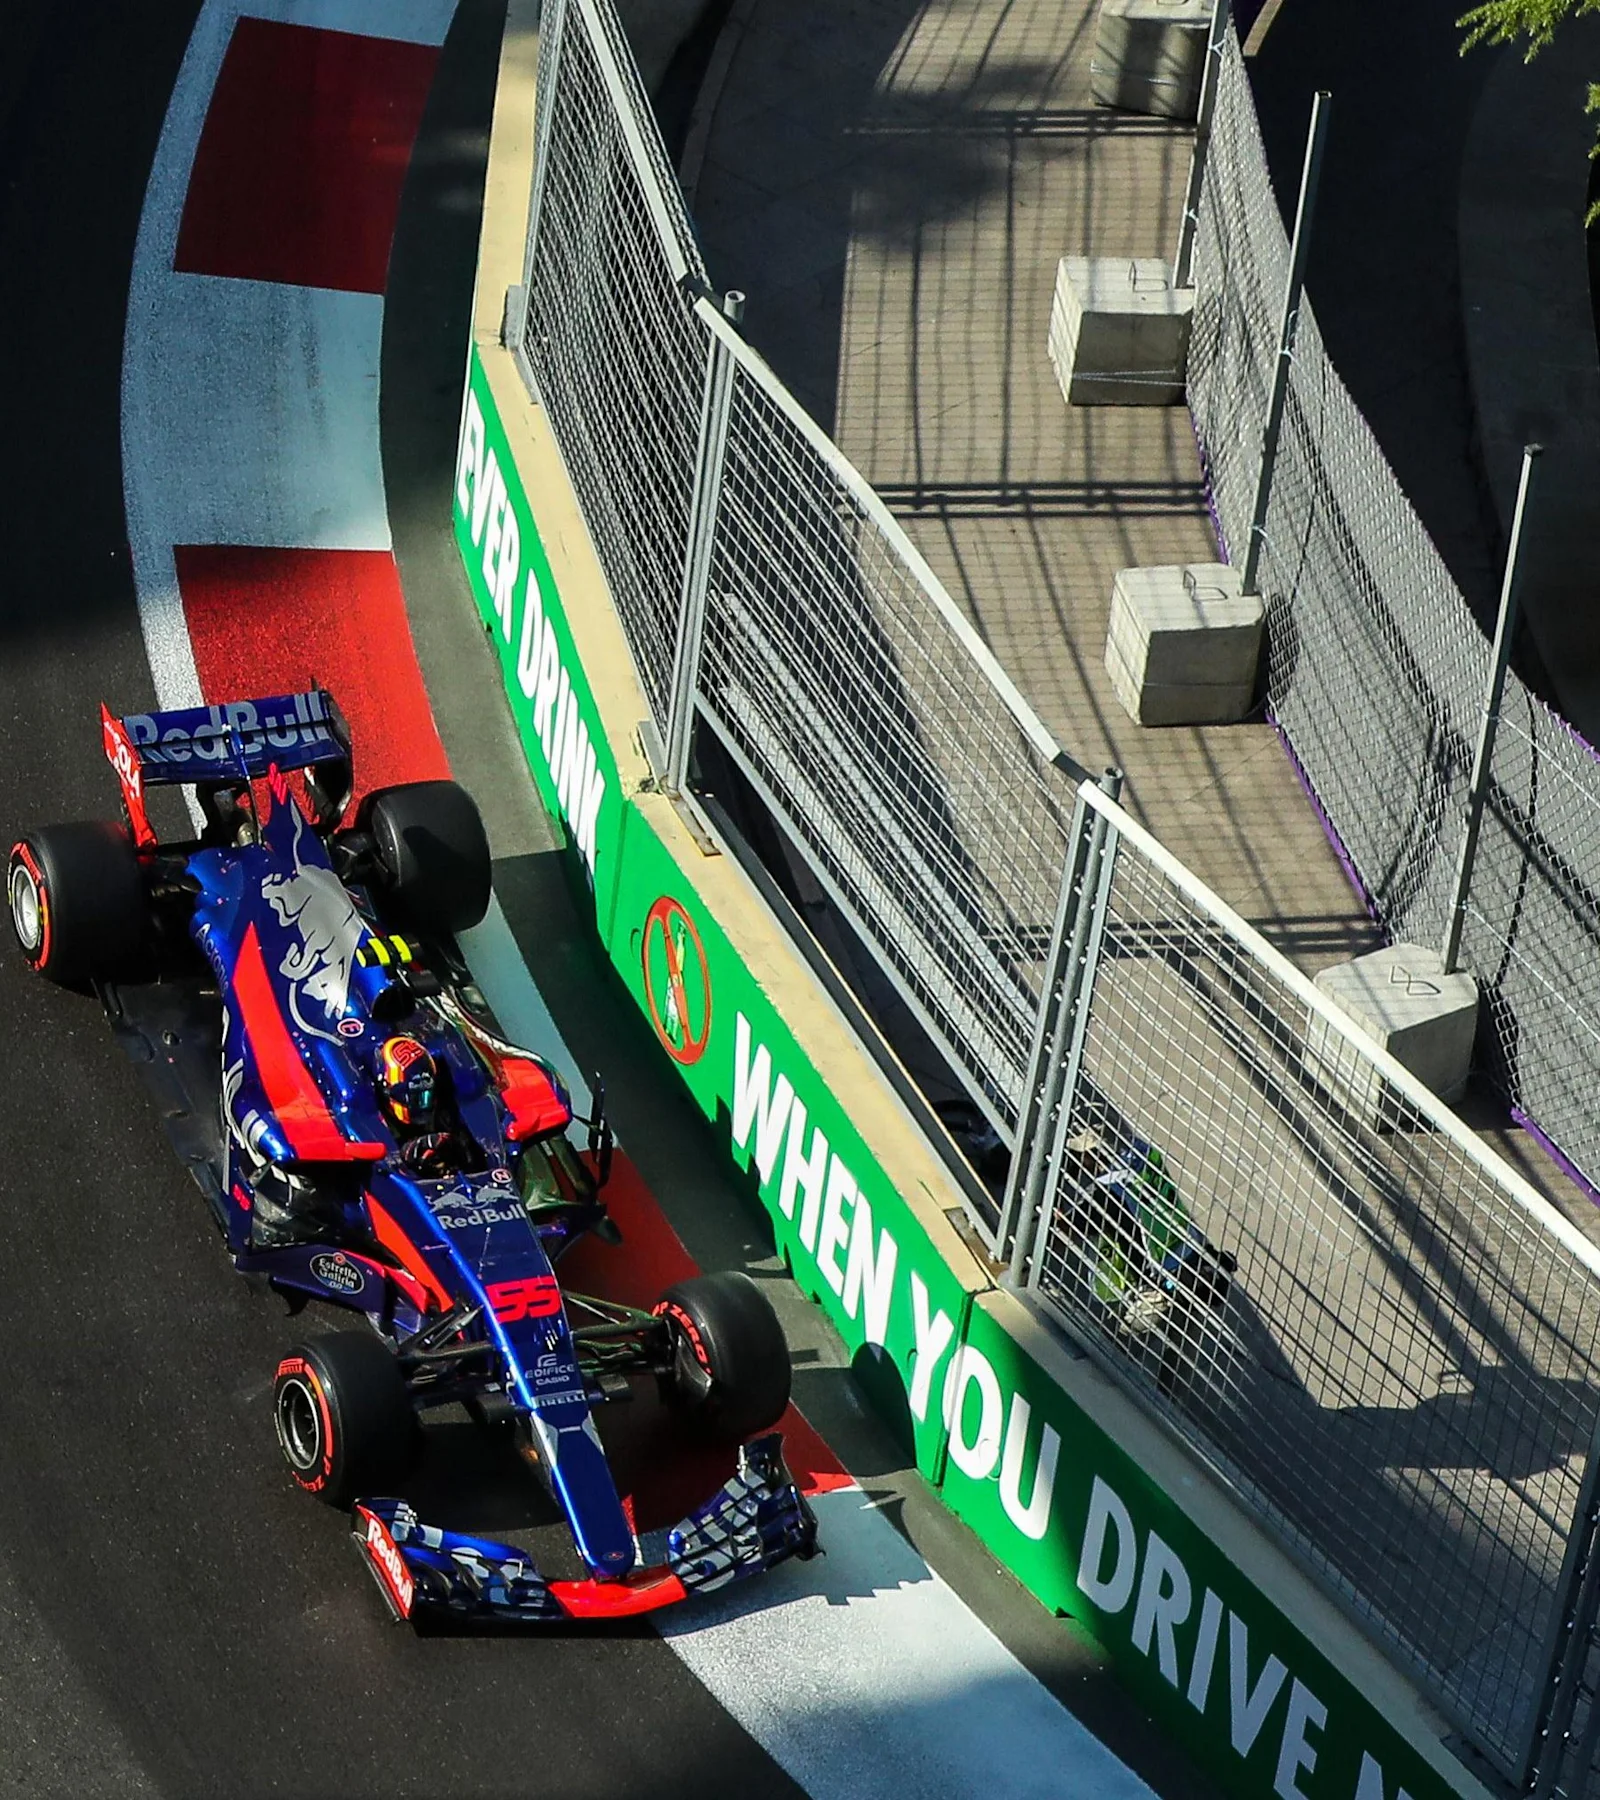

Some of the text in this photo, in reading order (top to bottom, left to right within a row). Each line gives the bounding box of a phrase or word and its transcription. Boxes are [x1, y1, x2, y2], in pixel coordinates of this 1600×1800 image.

[517, 567, 607, 882] DRINK
[731, 1010, 898, 1362] WHEN
[908, 1270, 1062, 1541] YOU
[1077, 1474, 1329, 1800] DRIVE
[485, 1275, 562, 1324] 55
[670, 1303, 708, 1364] ZERO
[525, 1363, 575, 1379] EDIFICE
[535, 1374, 570, 1386] CASIO
